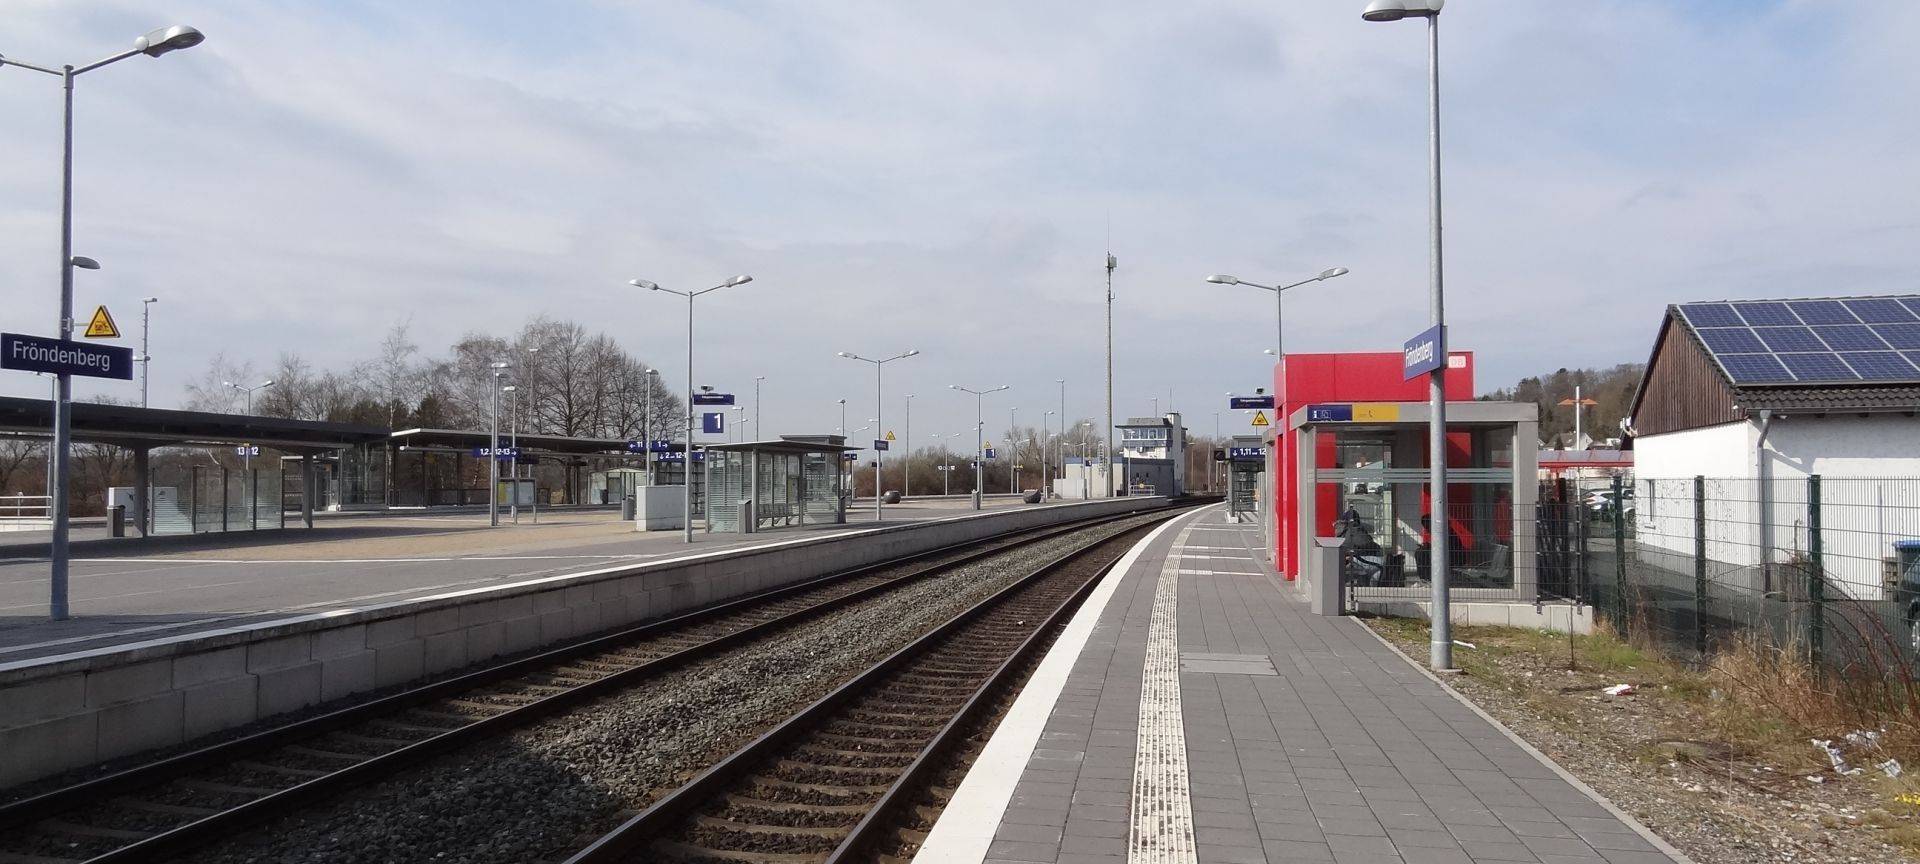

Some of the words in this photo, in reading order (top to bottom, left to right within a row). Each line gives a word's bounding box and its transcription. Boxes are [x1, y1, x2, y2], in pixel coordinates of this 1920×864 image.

[13, 340, 110, 371] Fröndenberg
[1405, 340, 1433, 369] Fröndenberg
[714, 413, 721, 429] 1
[237, 446, 245, 455] 13
[251, 446, 259, 455] 12
[494, 448, 511, 456] 12-13
[1239, 448, 1252, 456] 1,11
